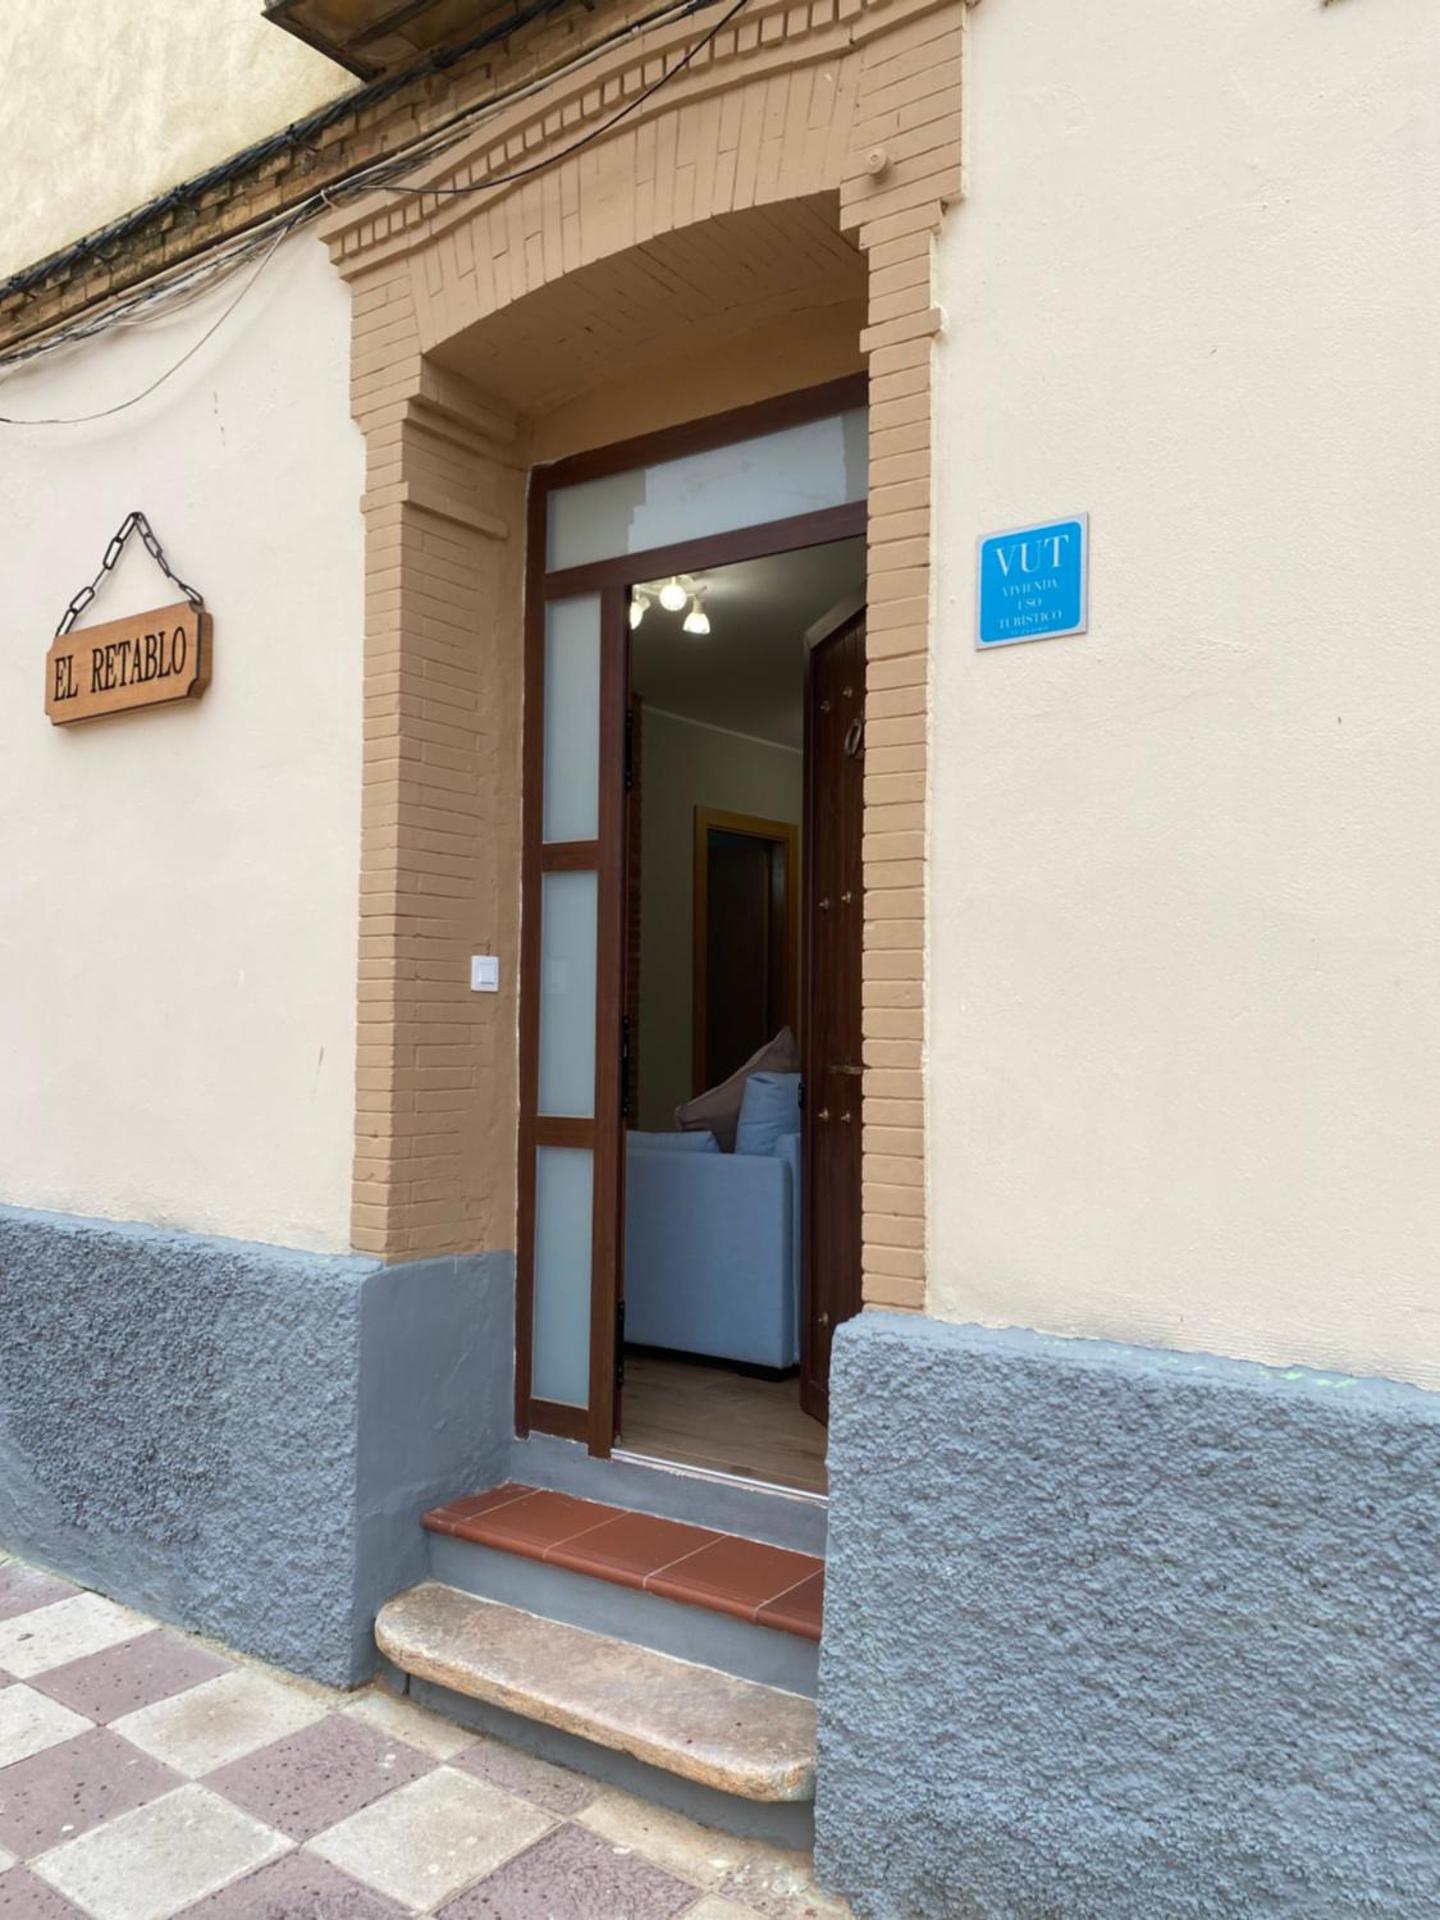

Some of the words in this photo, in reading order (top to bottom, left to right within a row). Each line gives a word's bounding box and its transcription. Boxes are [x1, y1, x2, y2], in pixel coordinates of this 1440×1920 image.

[996, 534, 1070, 577] VUT
[1002, 578, 1058, 597] VIVIENDA
[1017, 598, 1043, 611] USO
[53, 655, 79, 702] EL
[90, 626, 187, 693] RETABLO
